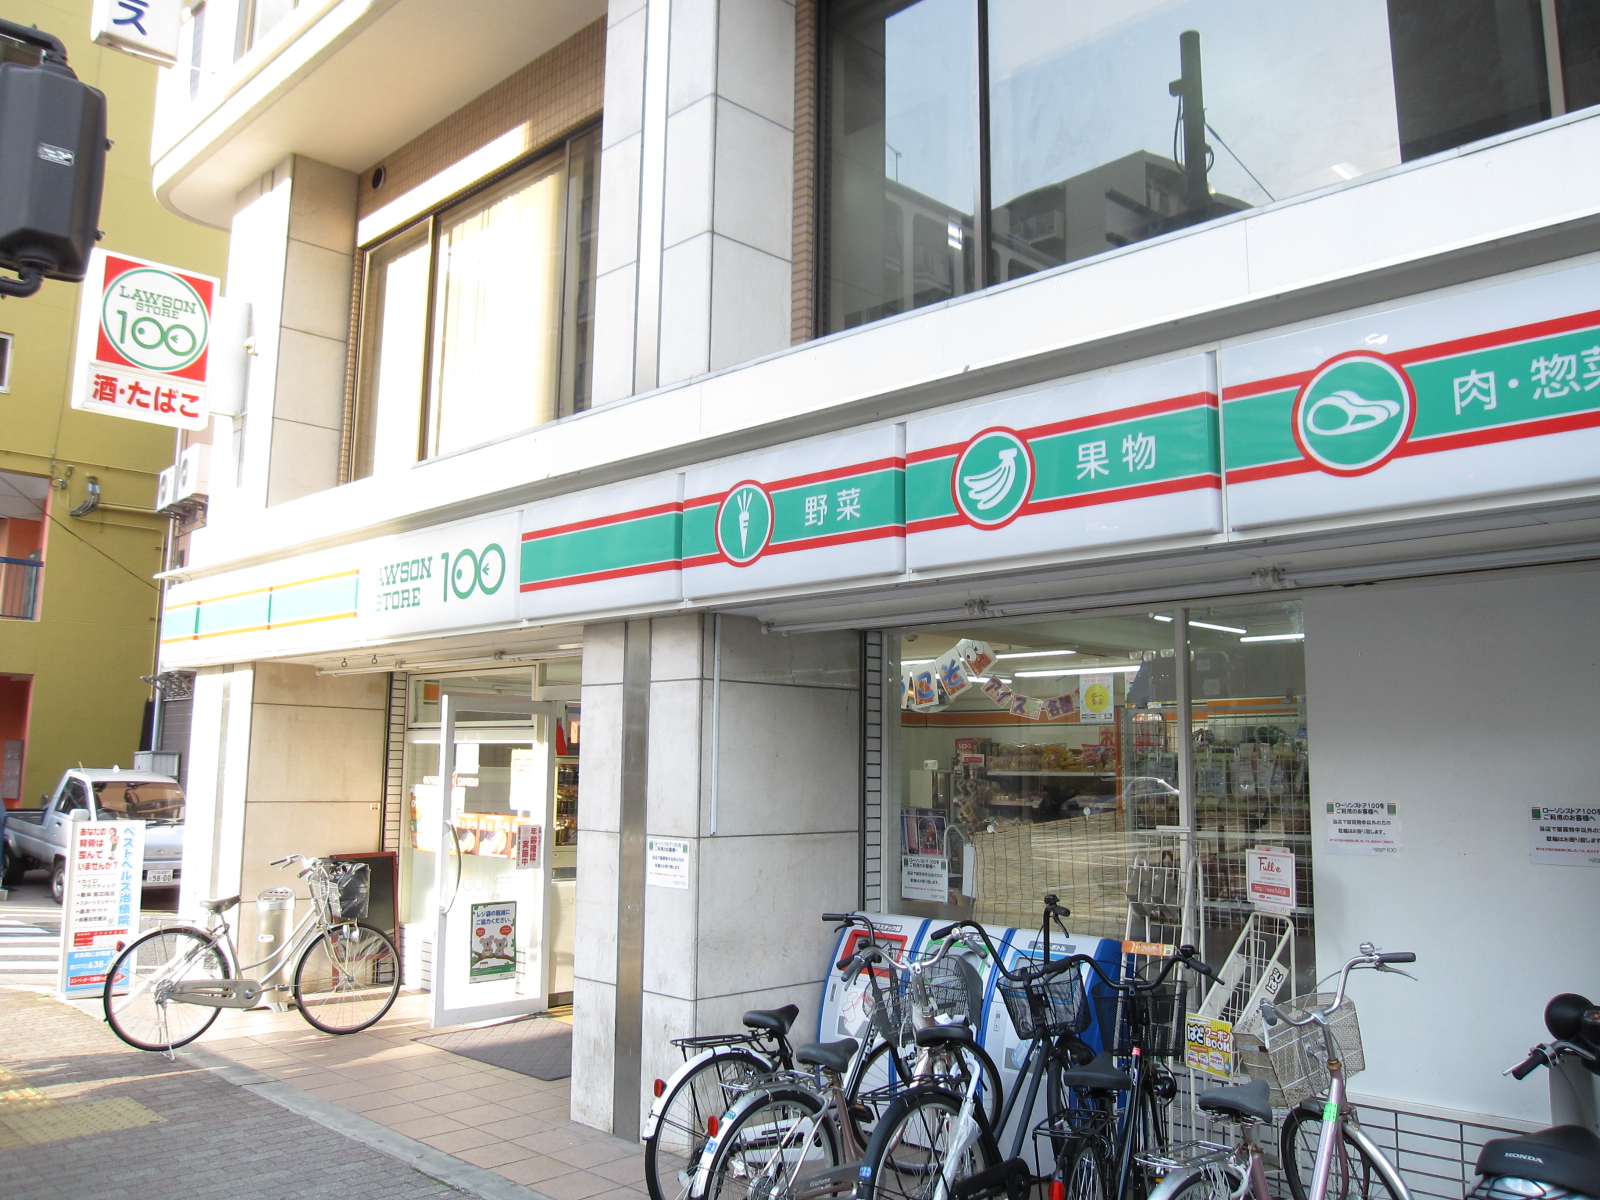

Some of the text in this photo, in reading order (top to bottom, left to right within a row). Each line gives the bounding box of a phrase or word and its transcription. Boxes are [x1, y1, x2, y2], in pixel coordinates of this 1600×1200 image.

[112, 0, 149, 36] ス
[119, 285, 197, 314] LAWSON
[136, 301, 180, 319] STORE
[116, 310, 197, 356] 100
[92, 373, 200, 418] 酒・たばこ
[1076, 432, 1156, 480] 果物
[805, 487, 861, 526] 野菜
[376, 556, 432, 587] AWSON
[441, 543, 506, 602] 100
[1205, 1026, 1230, 1042] クーポン
[1205, 1038, 1231, 1053] BOOK
[1504, 1152, 1544, 1164] HONDA
